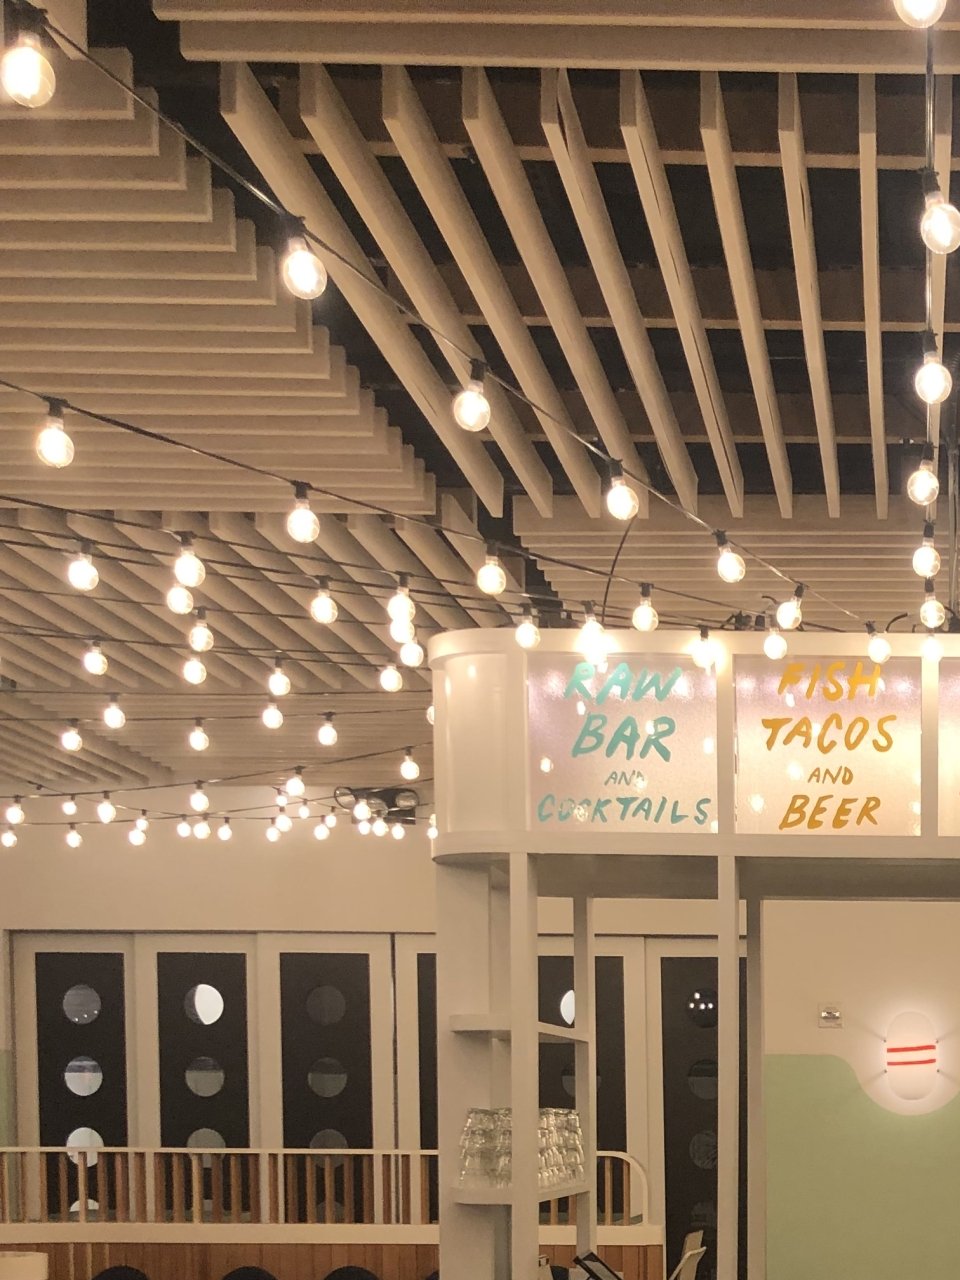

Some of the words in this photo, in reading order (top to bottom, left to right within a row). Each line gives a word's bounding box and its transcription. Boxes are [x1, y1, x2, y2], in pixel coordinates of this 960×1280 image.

[563, 661, 682, 703] RAW
[777, 661, 881, 701] FISH
[571, 713, 676, 762] BAR
[761, 713, 897, 754] TACOS
[807, 765, 854, 786] AND
[778, 793, 881, 831] BEER
